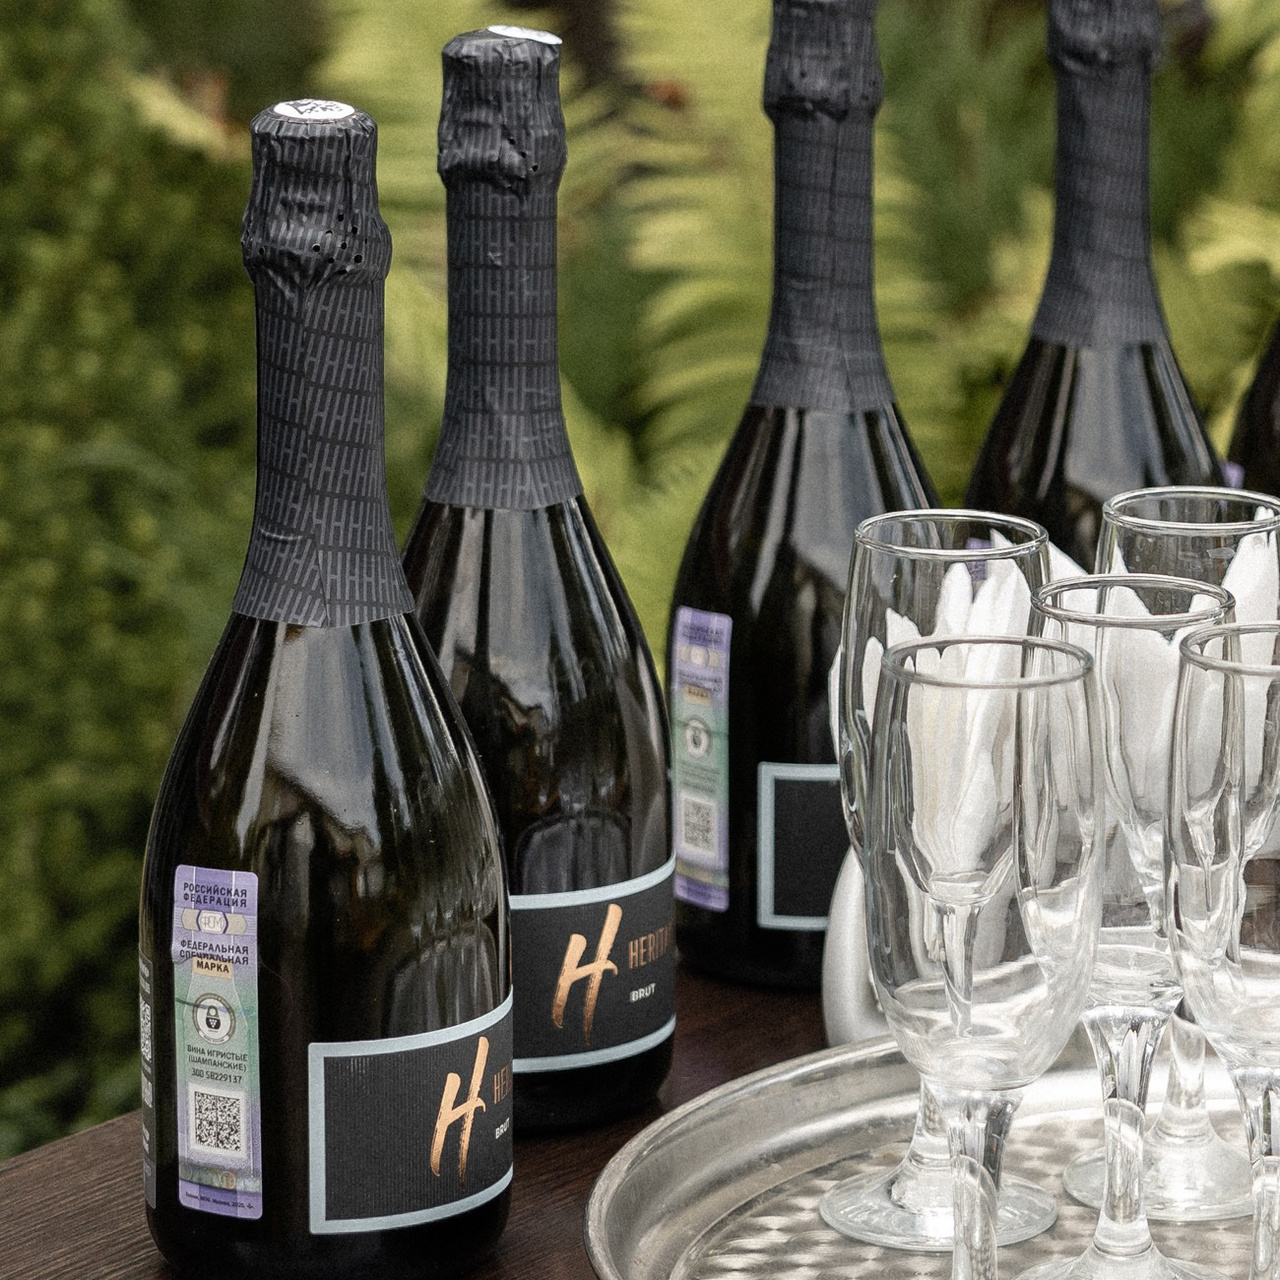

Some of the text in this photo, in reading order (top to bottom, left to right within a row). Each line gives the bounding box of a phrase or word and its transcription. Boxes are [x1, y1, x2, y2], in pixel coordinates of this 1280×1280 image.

[183, 882, 247, 898] РОССИЙСКАЯ
[183, 892, 247, 908] ФЕДЕРАЦИЯ
[180, 939, 249, 955] ФЕДЕРАЛЬНАЯ
[180, 949, 249, 965] СПЕЦИАЛЬНАЯ
[196, 960, 230, 973] МАРКА
[552, 903, 623, 1046] H
[629, 982, 657, 1003] BRUT
[187, 1044, 248, 1061] ВИНА ИГРИСТЫЕ
[188, 1055, 247, 1072] (ШАМПАНСКИЕ)
[429, 1036, 490, 1190] H
